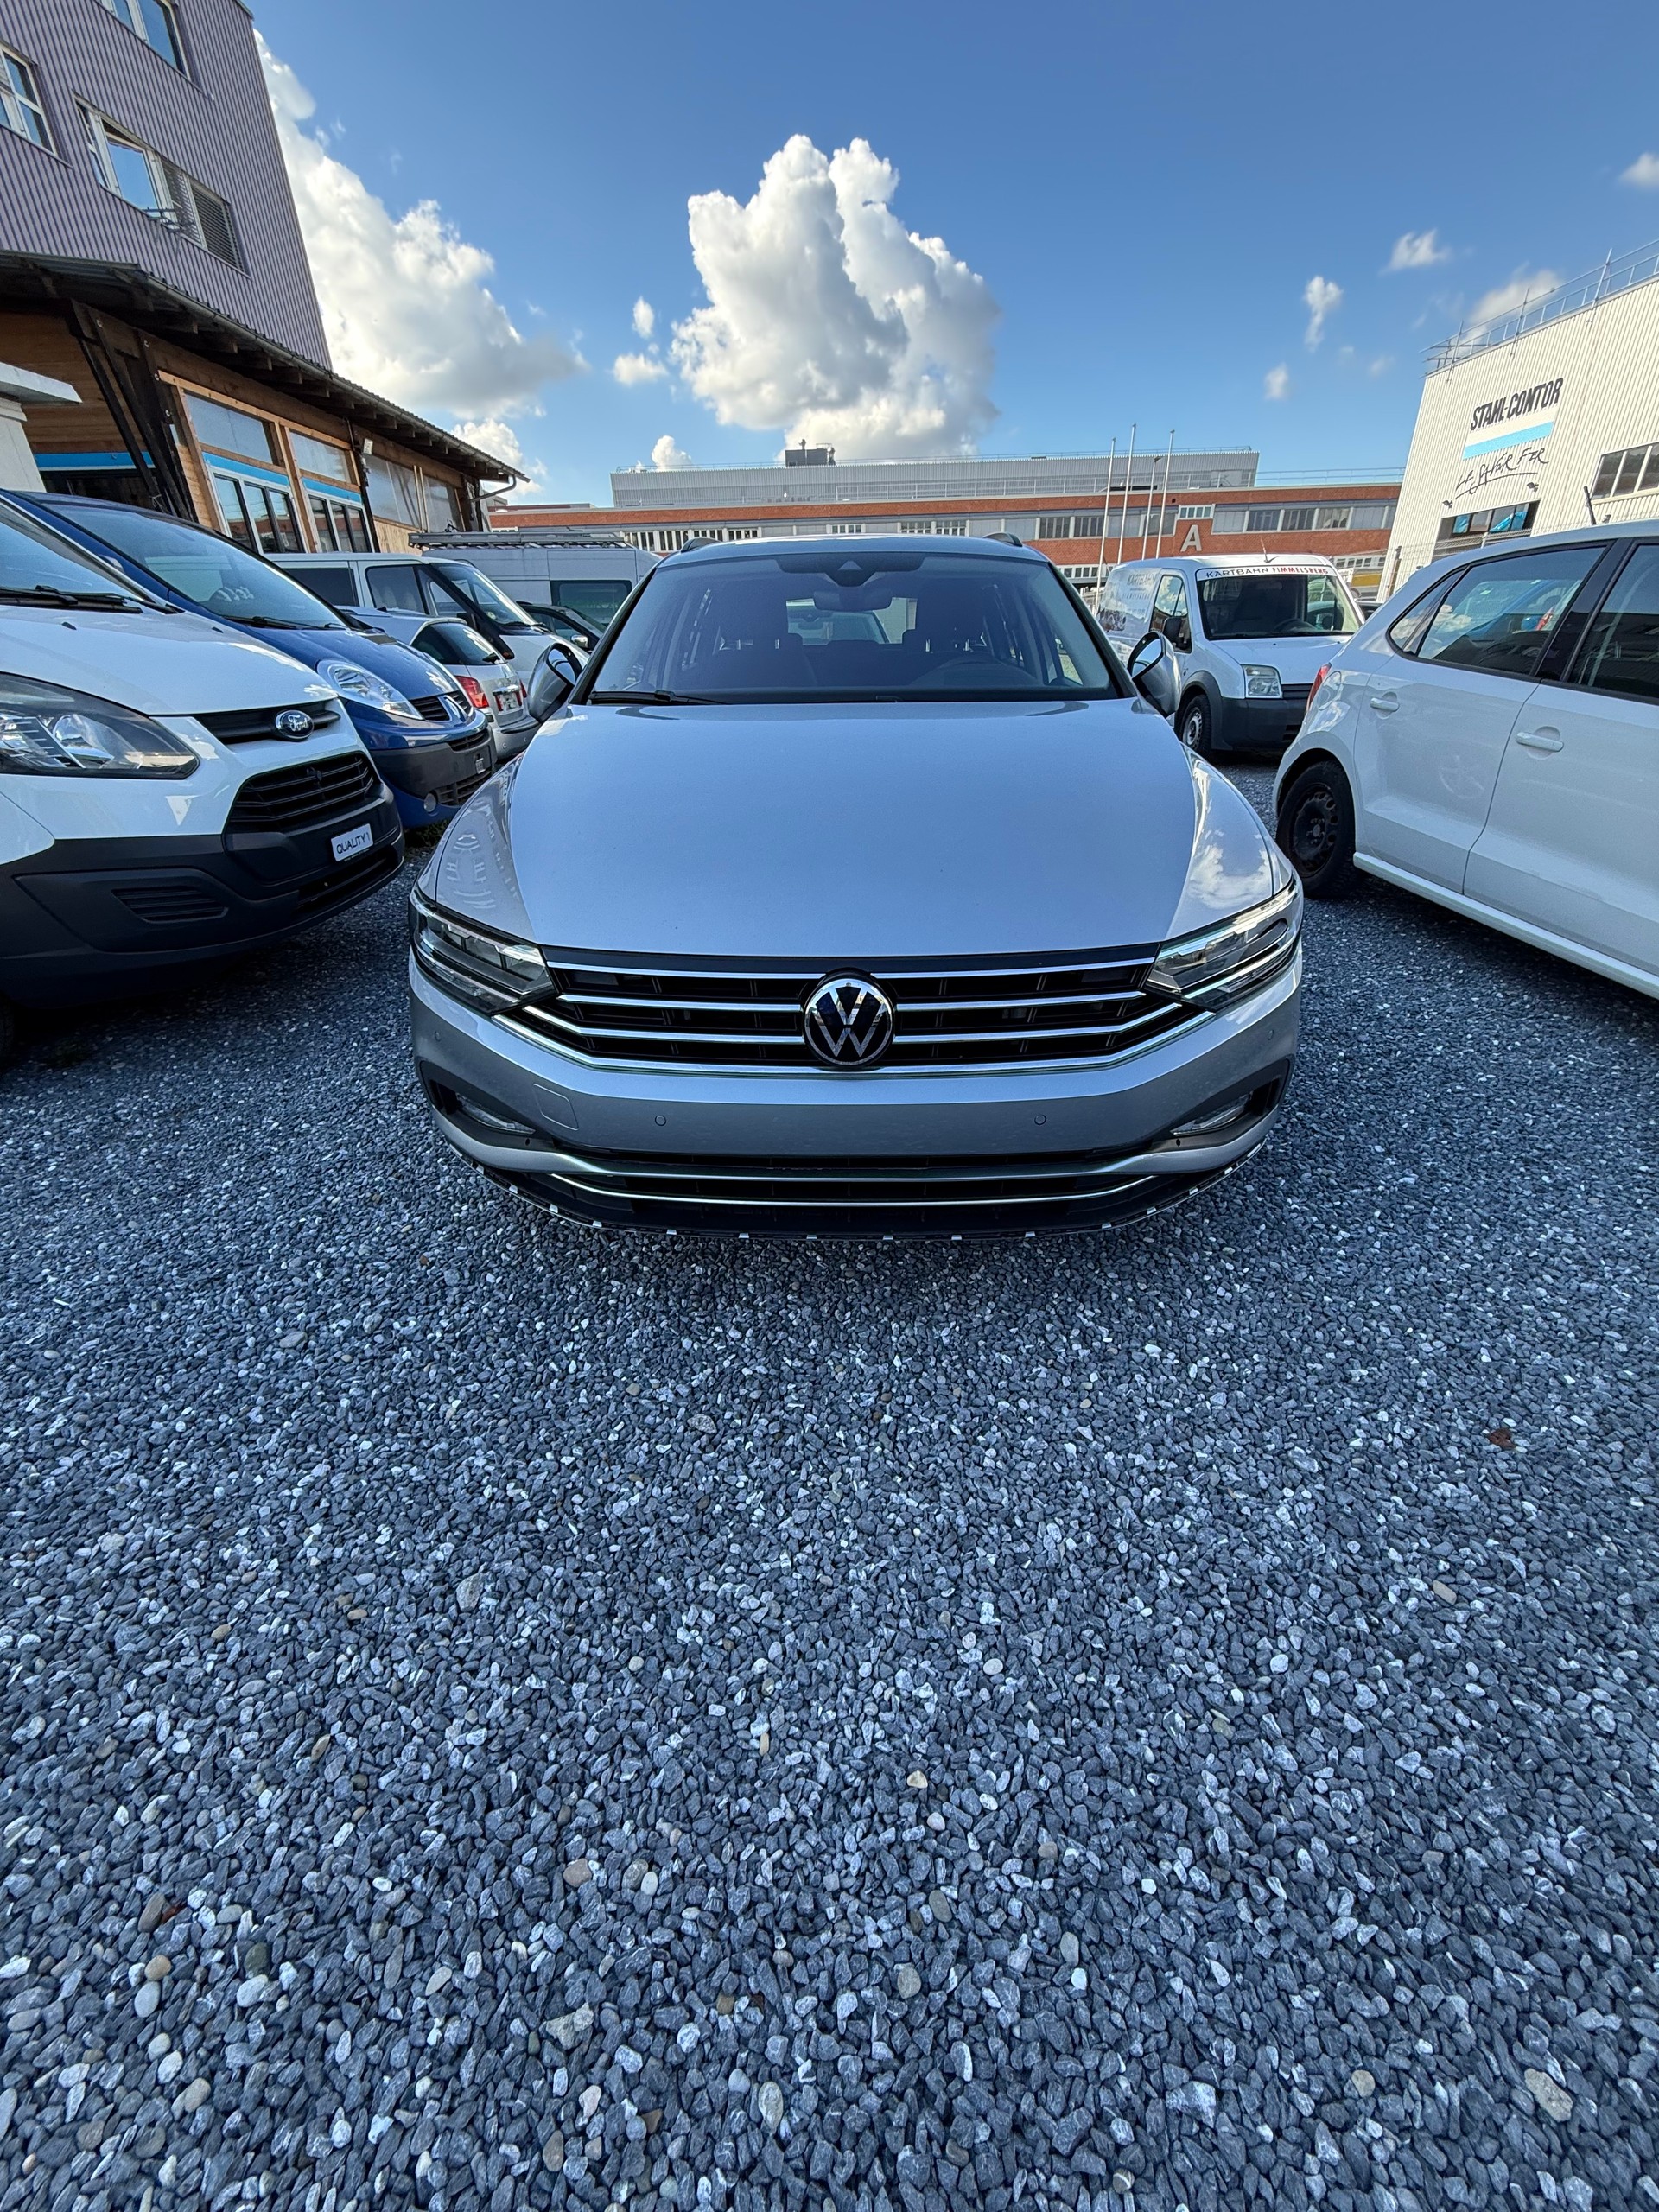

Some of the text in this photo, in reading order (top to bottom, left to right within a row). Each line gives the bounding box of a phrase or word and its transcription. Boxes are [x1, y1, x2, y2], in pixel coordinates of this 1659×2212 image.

[1470, 377, 1564, 431] STAHL-CONTOR
[1180, 524, 1202, 552] A
[1205, 568, 1269, 578] KARTBAHN
[288, 714, 309, 732] Ford
[336, 833, 365, 855] QUALITY
